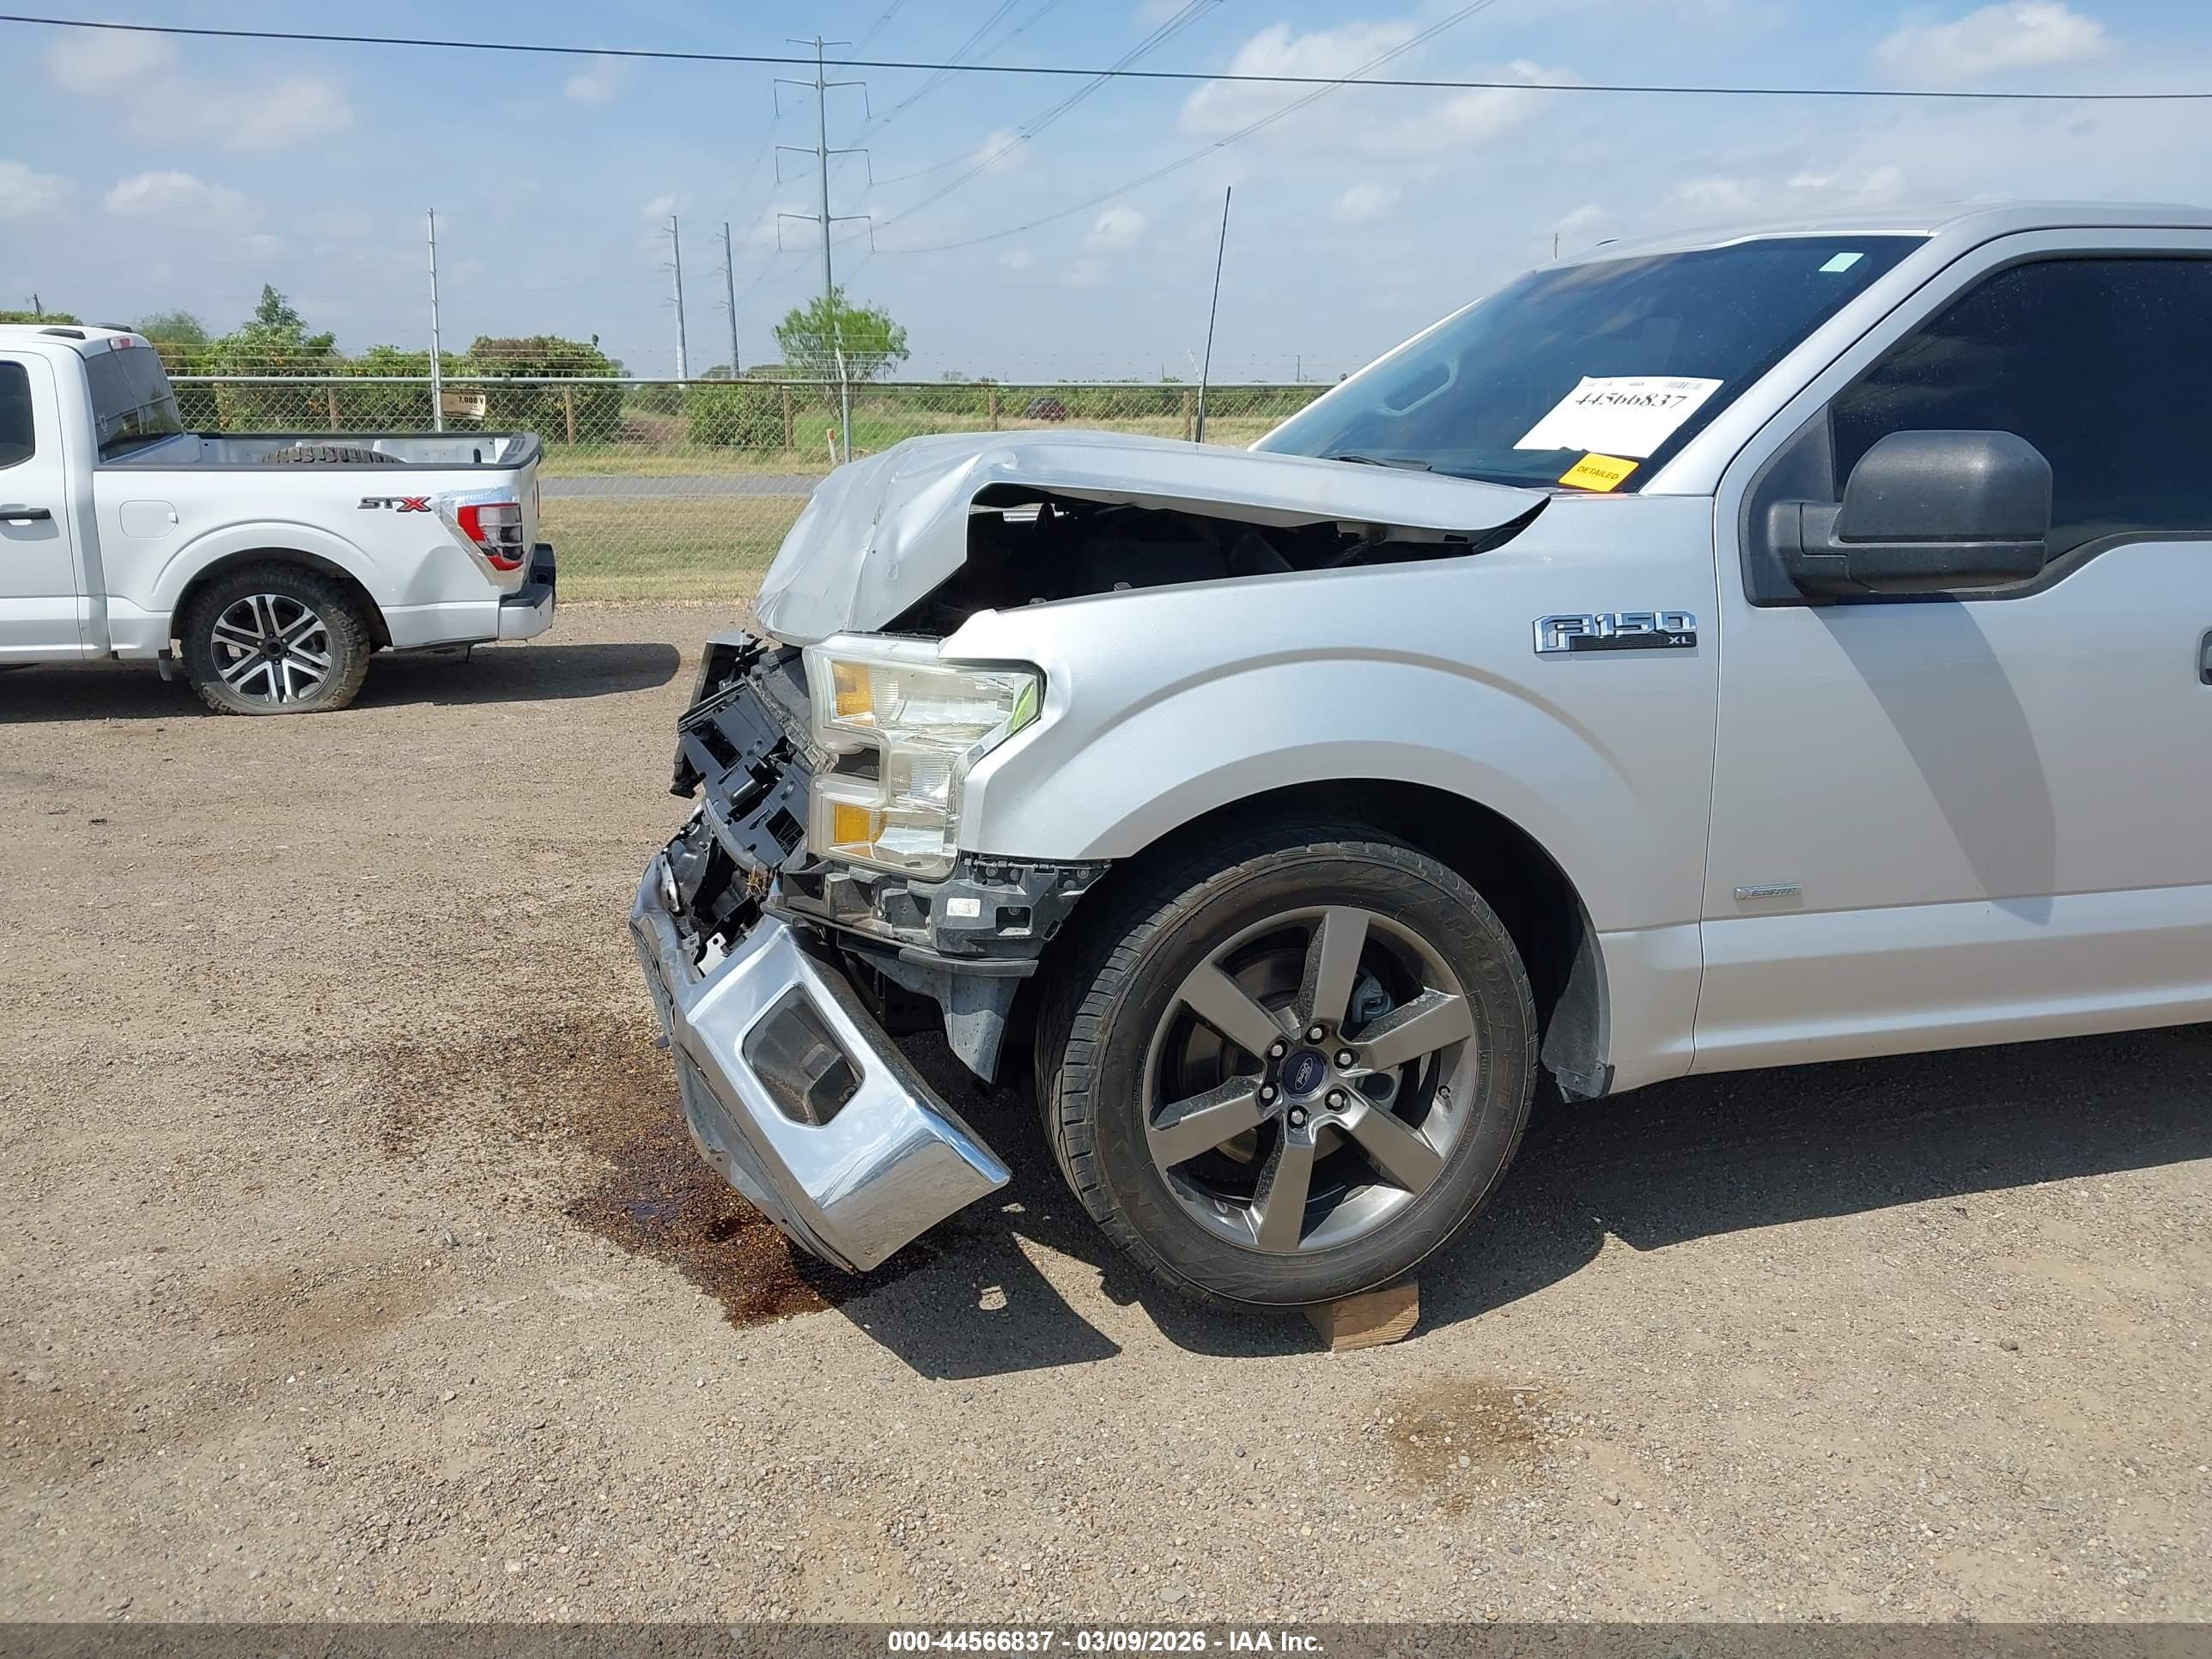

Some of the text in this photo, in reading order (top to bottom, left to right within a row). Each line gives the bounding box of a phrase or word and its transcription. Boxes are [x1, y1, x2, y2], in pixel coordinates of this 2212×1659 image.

[1575, 392, 1689, 410] 44566837
[1577, 465, 1620, 481] DETAILED
[357, 496, 432, 513] STX
[1668, 635, 1692, 645] XL
